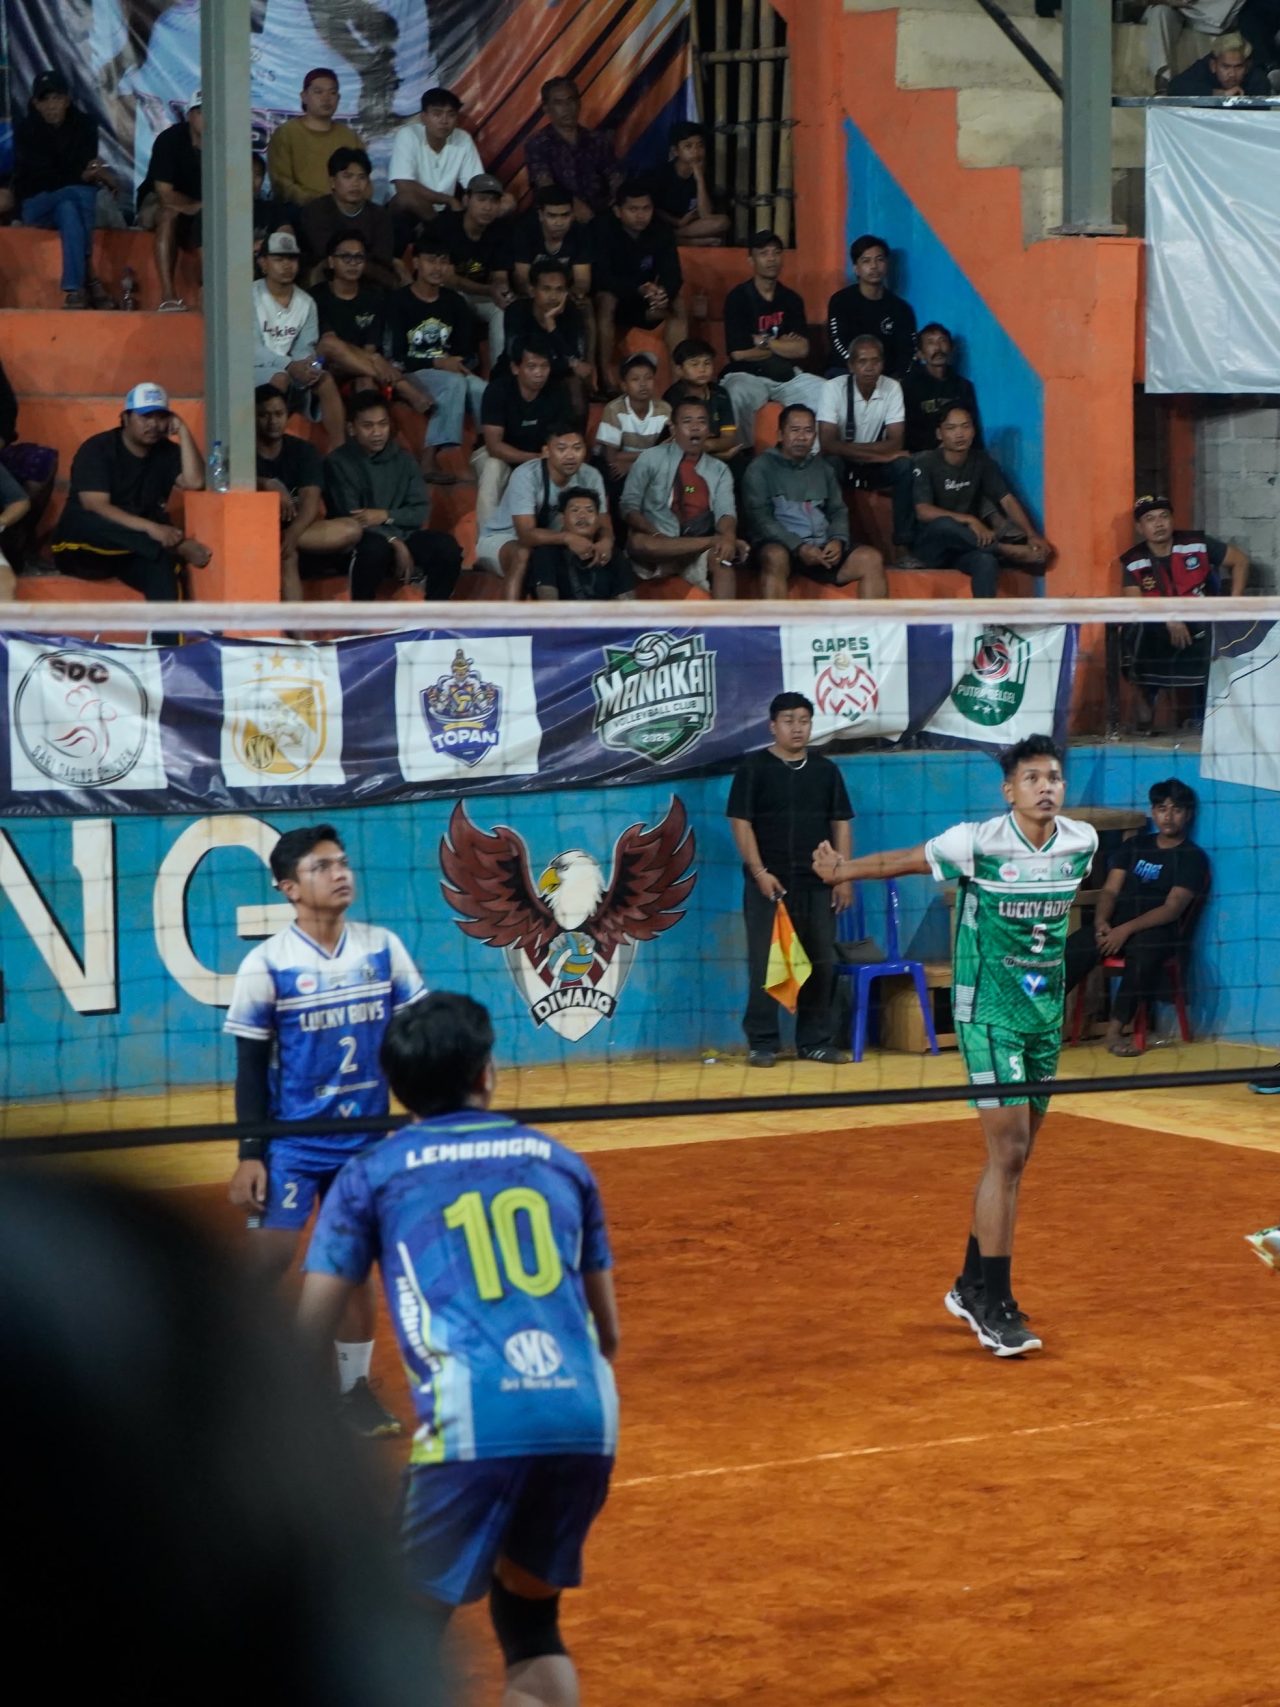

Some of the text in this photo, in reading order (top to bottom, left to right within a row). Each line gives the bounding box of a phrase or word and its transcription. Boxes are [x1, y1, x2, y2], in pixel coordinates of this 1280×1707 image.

[812, 636, 869, 653] GAPES
[597, 658, 705, 723] MANAKA
[432, 730, 497, 749] TOPAN
[999, 901, 1042, 919] LUCKY
[1030, 923, 1047, 953] 5
[300, 999, 385, 1032] LUCKY BOYS
[533, 988, 613, 1019] DIWANG
[338, 1036, 358, 1074] 2
[406, 1137, 552, 1169] LEMBONGAN
[281, 1182, 298, 1209] 2
[443, 1187, 562, 1301] 10
